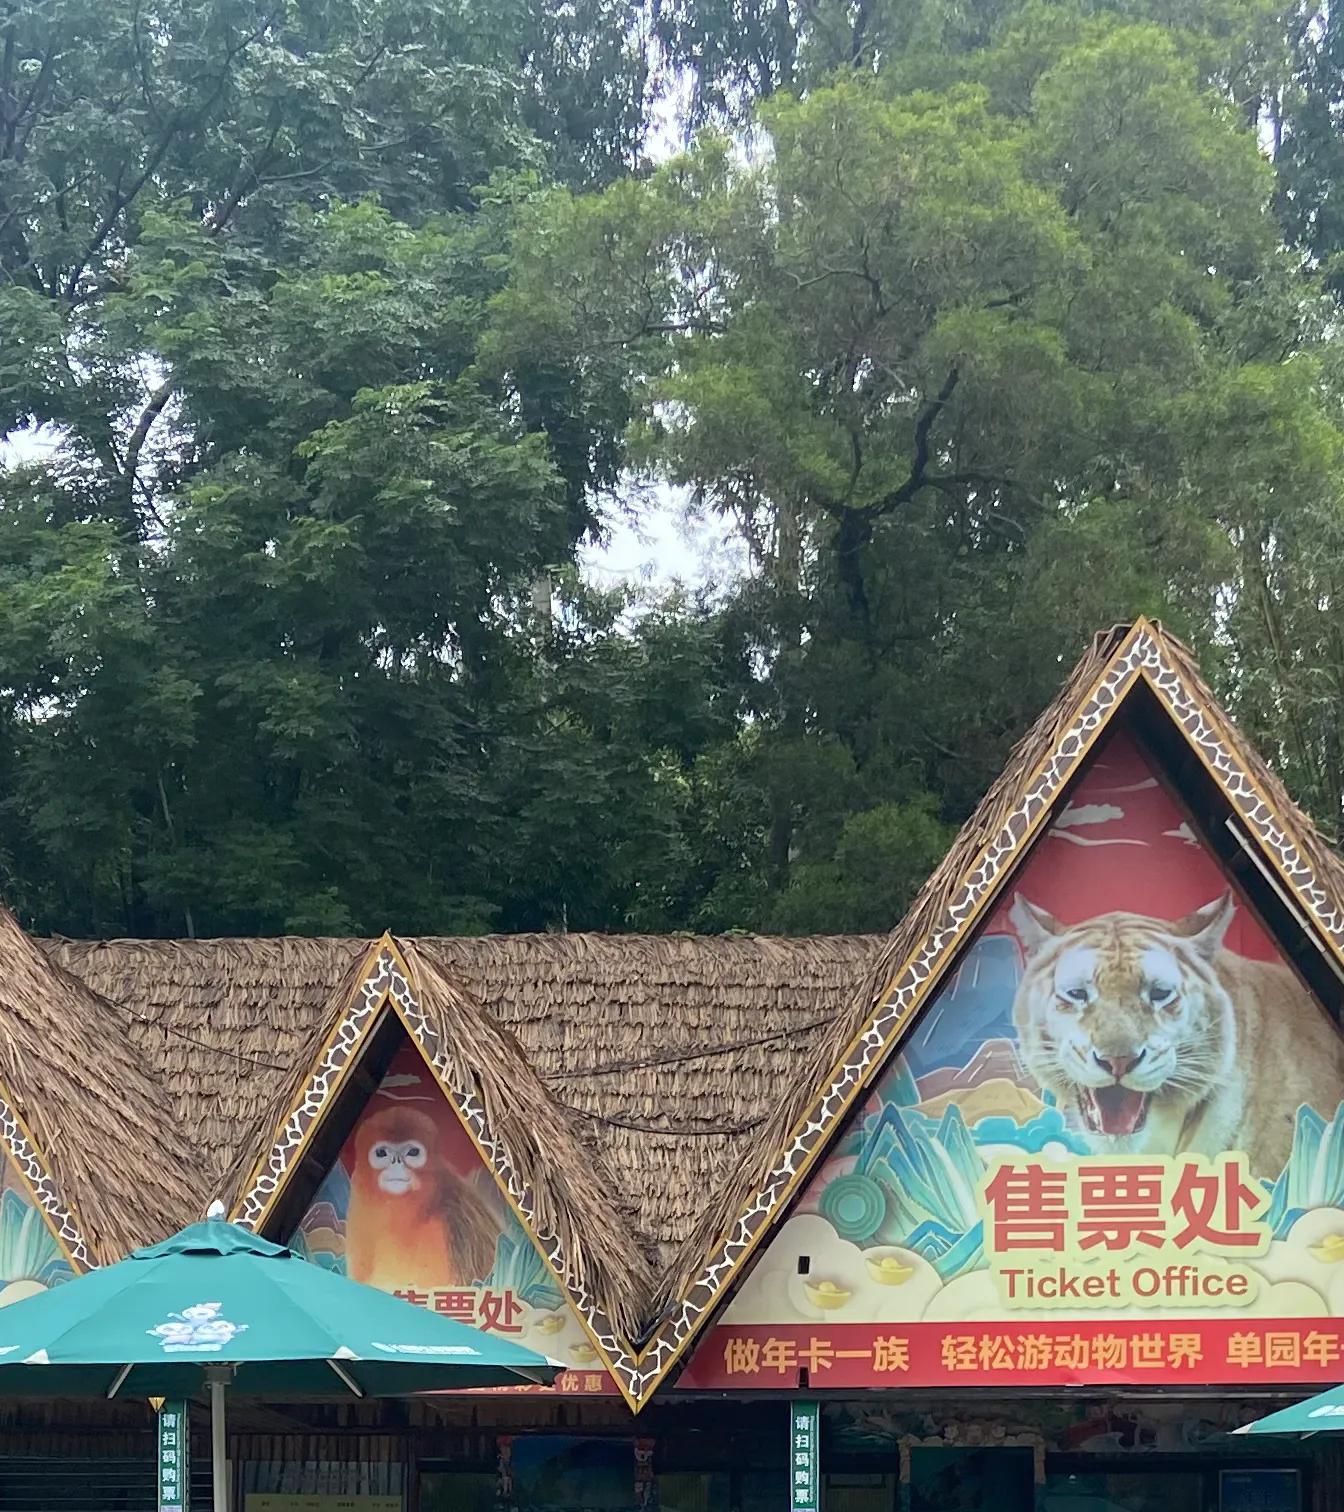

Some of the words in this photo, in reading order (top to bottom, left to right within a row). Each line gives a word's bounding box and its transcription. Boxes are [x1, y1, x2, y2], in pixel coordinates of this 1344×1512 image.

[984, 1161, 1262, 1252] 售票处
[999, 1267, 1121, 1299] Ticket
[1132, 1265, 1249, 1297] Office
[723, 1337, 910, 1375] 做年卡一族
[940, 1333, 1205, 1372] 轻松游动物世界
[794, 1416, 809, 1504] 请扫码购票
